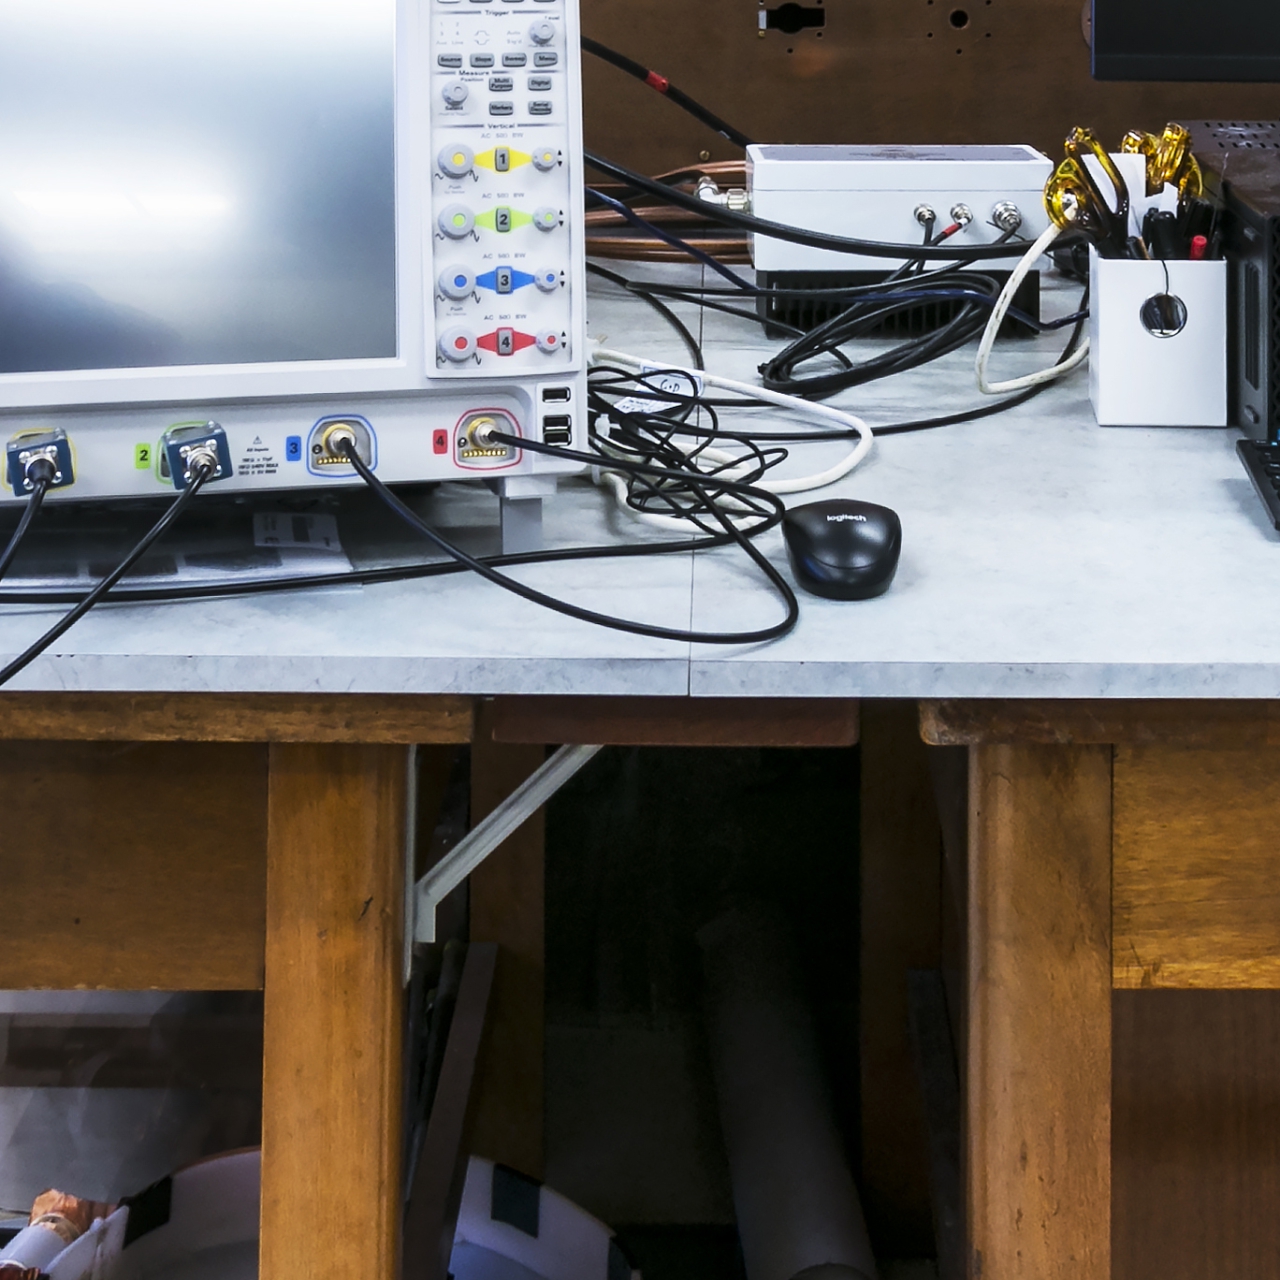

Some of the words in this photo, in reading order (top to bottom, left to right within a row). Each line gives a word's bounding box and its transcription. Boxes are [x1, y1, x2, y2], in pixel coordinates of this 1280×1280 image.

[500, 153, 506, 165] 1
[500, 213, 508, 225] 2
[500, 274, 509, 286] 3
[501, 336, 510, 348] 4
[435, 435, 445, 446] 4
[289, 442, 299, 454] 3
[139, 449, 149, 462] 2
[826, 513, 867, 523] logitech
